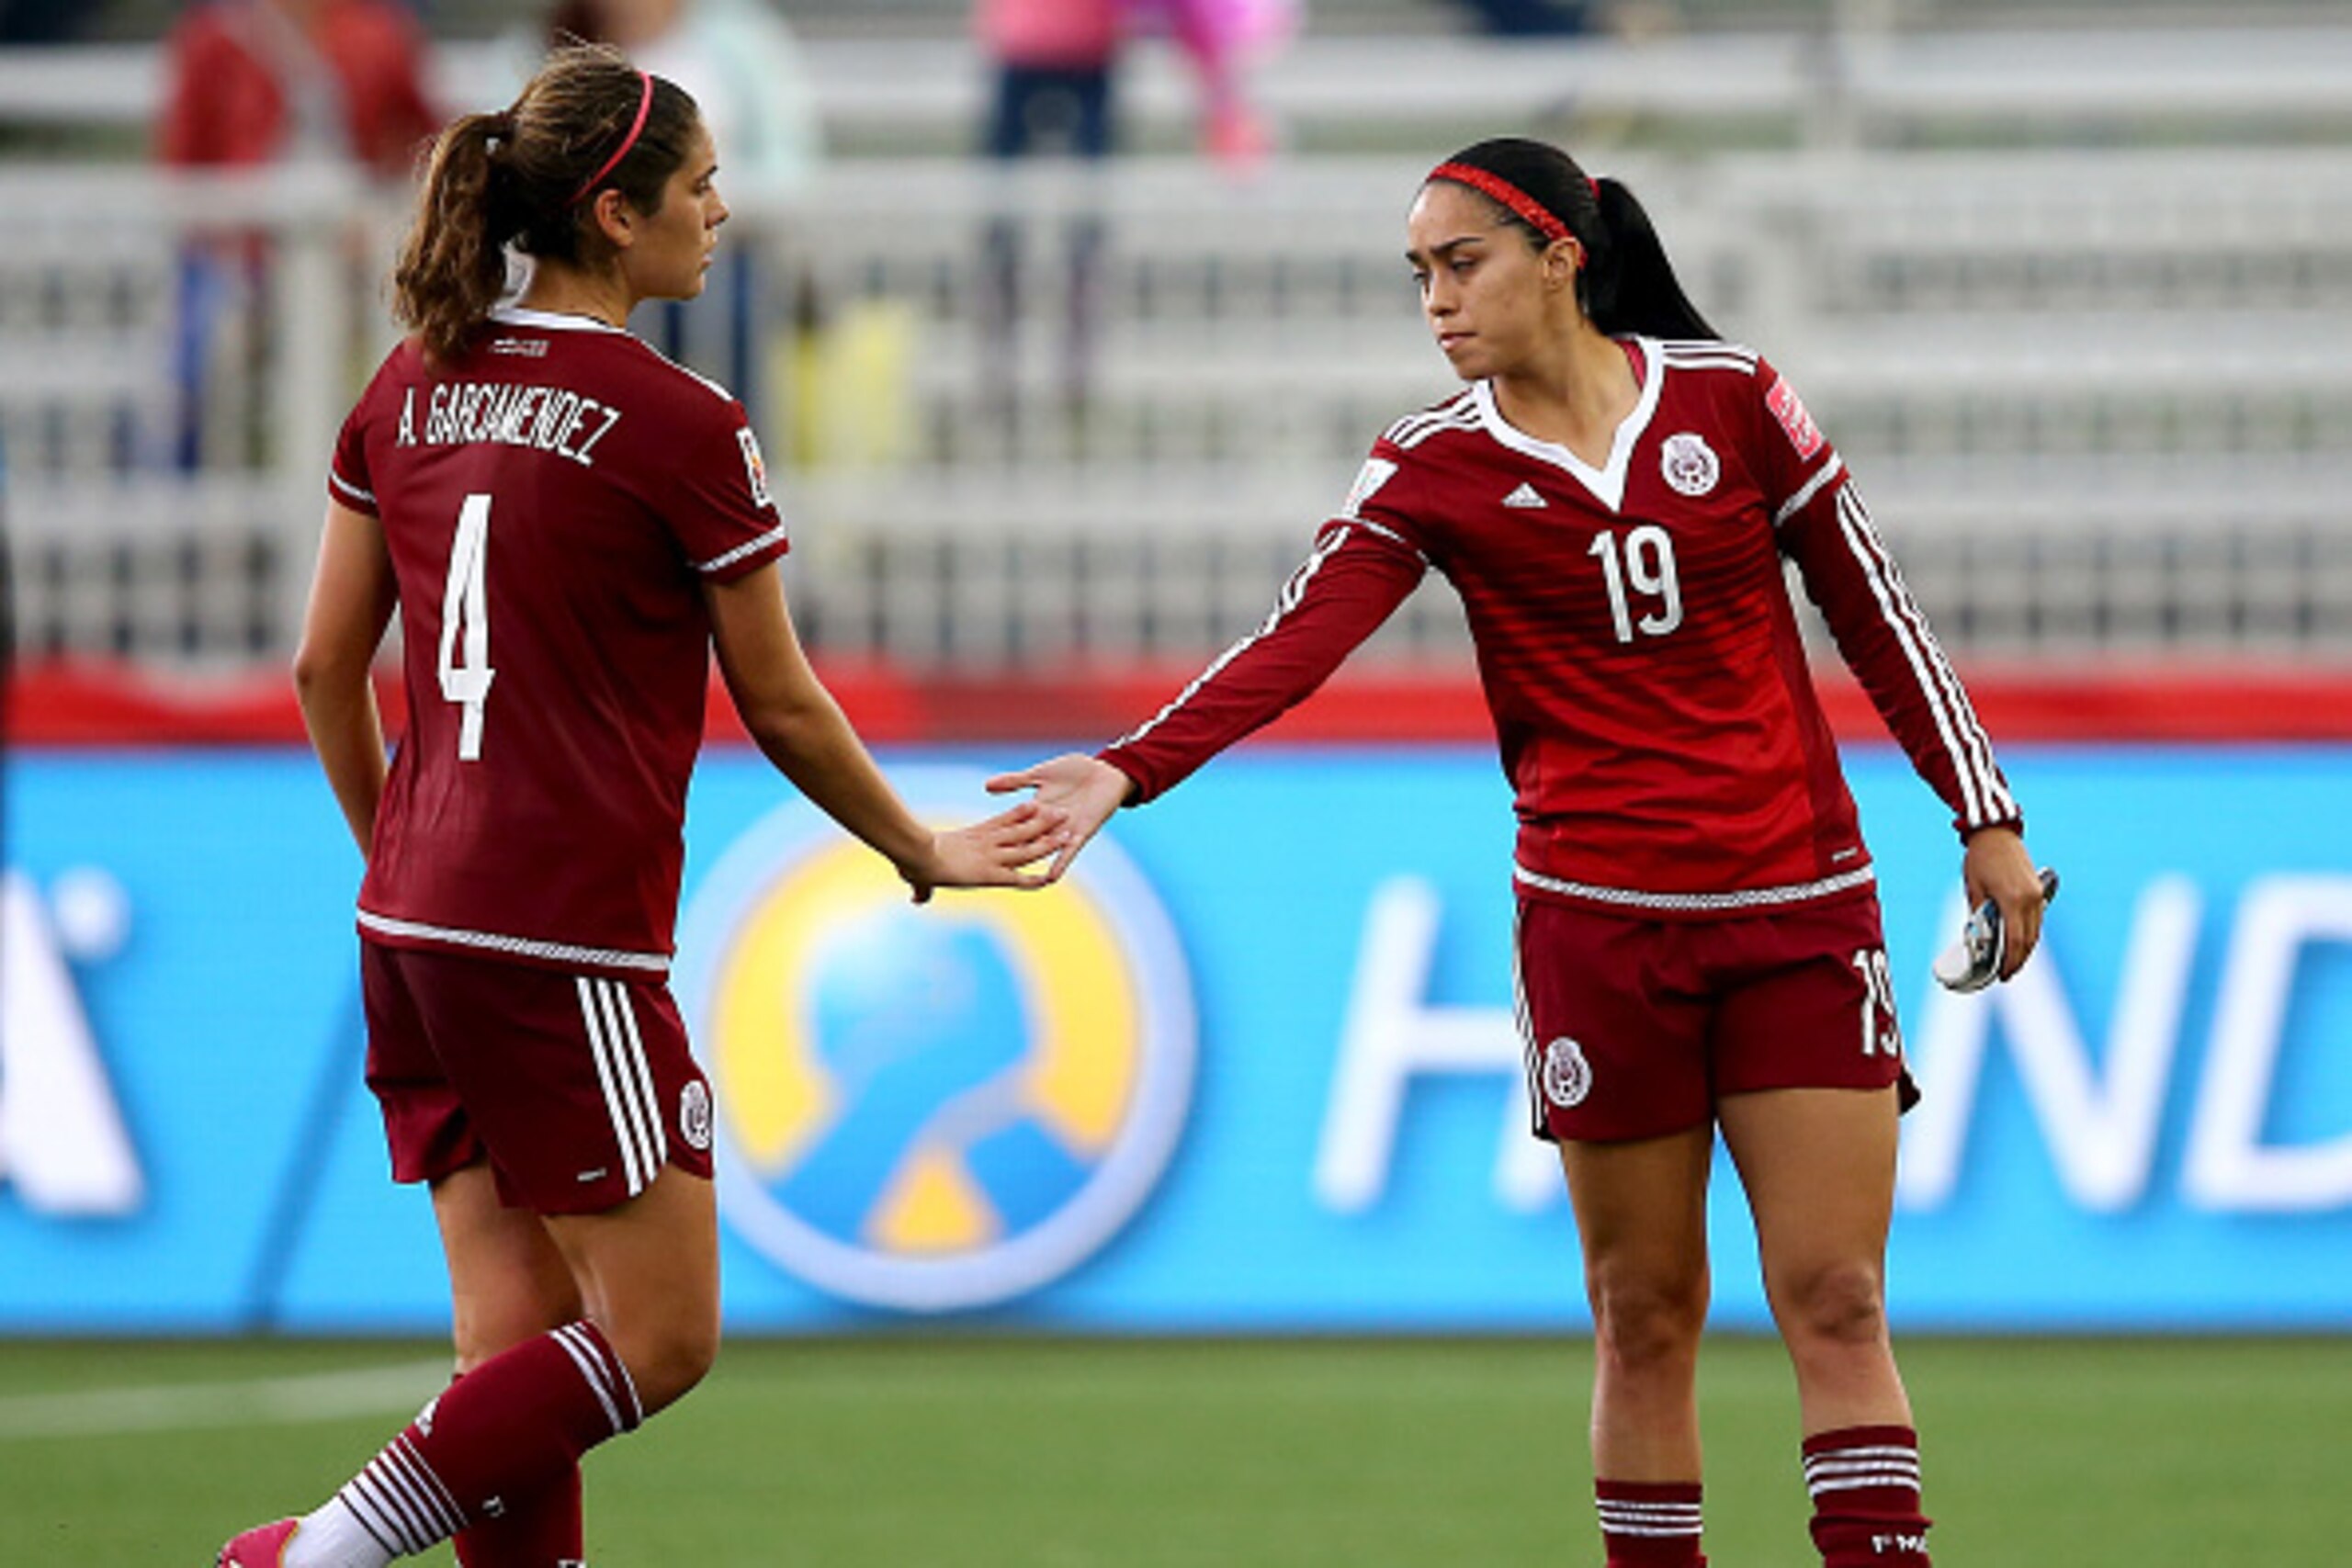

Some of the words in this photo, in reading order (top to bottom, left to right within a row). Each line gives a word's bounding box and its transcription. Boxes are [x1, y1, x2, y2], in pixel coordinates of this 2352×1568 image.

[396, 386, 417, 446] A.
[437, 494, 495, 761] 4
[1588, 525, 1684, 643] 19
[1853, 949, 1898, 1055] 19
